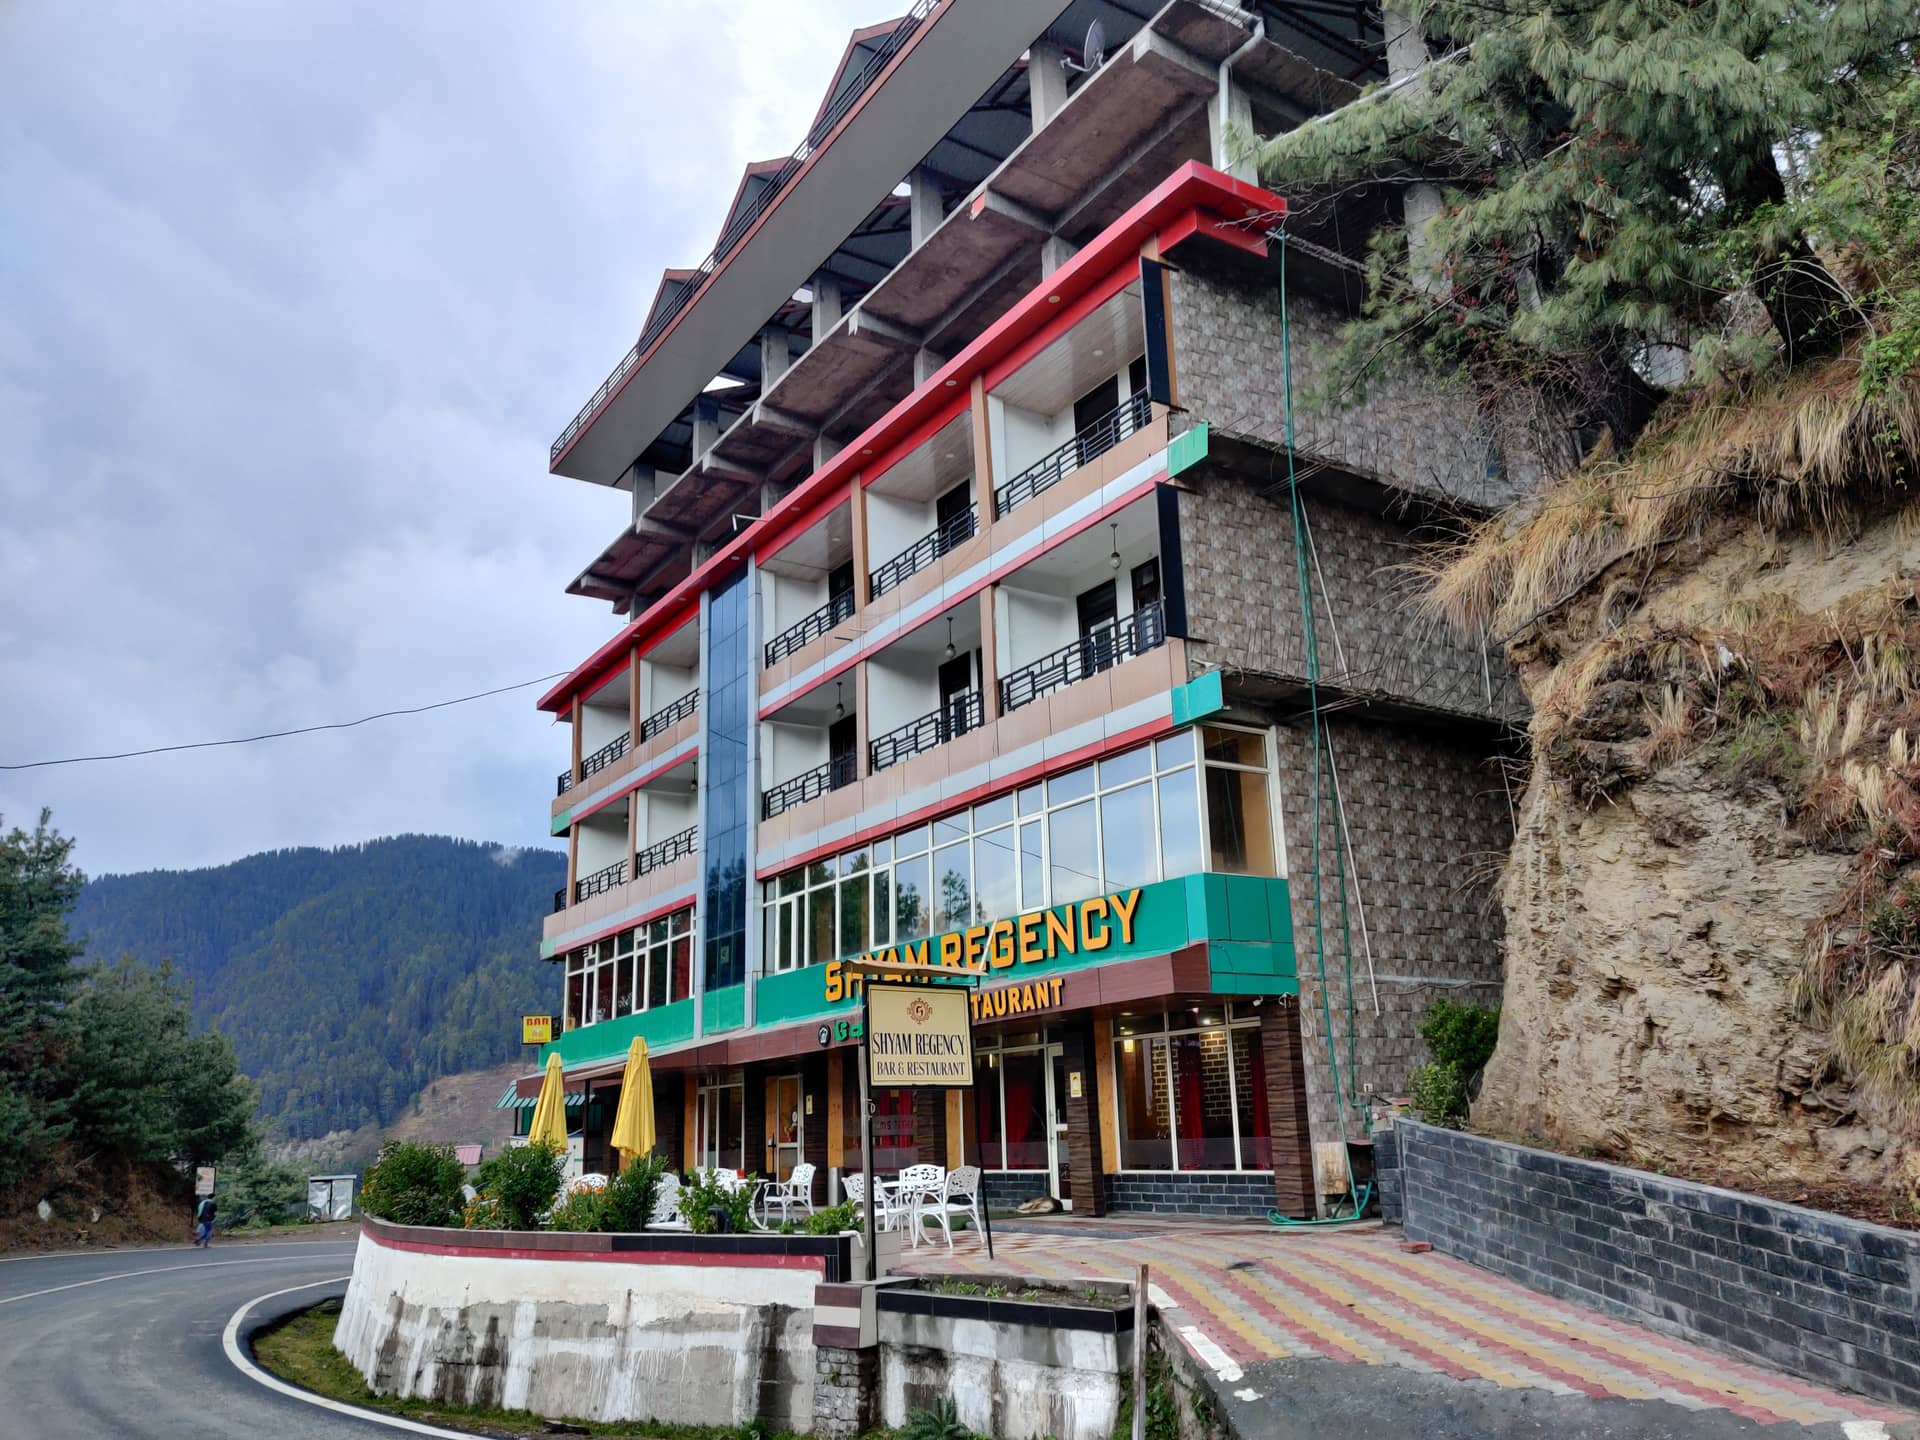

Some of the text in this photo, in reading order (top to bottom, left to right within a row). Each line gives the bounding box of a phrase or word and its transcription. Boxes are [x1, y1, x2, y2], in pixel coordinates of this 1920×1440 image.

[940, 888, 1141, 970] REGENCY
[971, 978, 1063, 1019] TAURANT
[872, 1032, 965, 1056] SHYAM REGENCY
[876, 1061, 966, 1076] BAR & RESTAURANT
